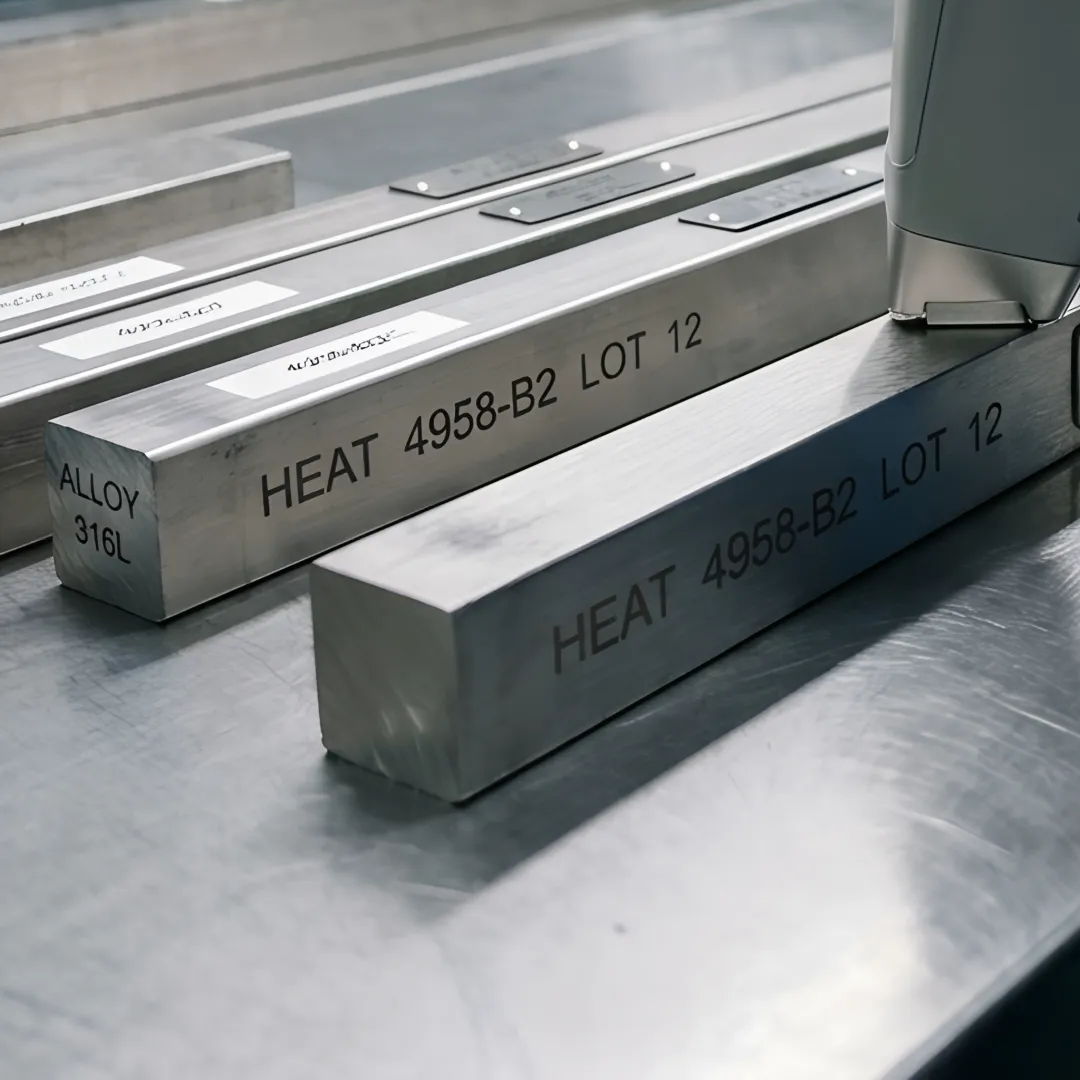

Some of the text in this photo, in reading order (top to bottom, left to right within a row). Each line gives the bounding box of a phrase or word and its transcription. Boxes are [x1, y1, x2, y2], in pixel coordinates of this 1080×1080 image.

[261, 312, 702, 517] HEAT 4958-B2 LOT 12
[59, 463, 140, 520] ALLOY
[74, 515, 131, 564] 316L
[553, 402, 1003, 674] HEAT 4958-B2 LOT 12
